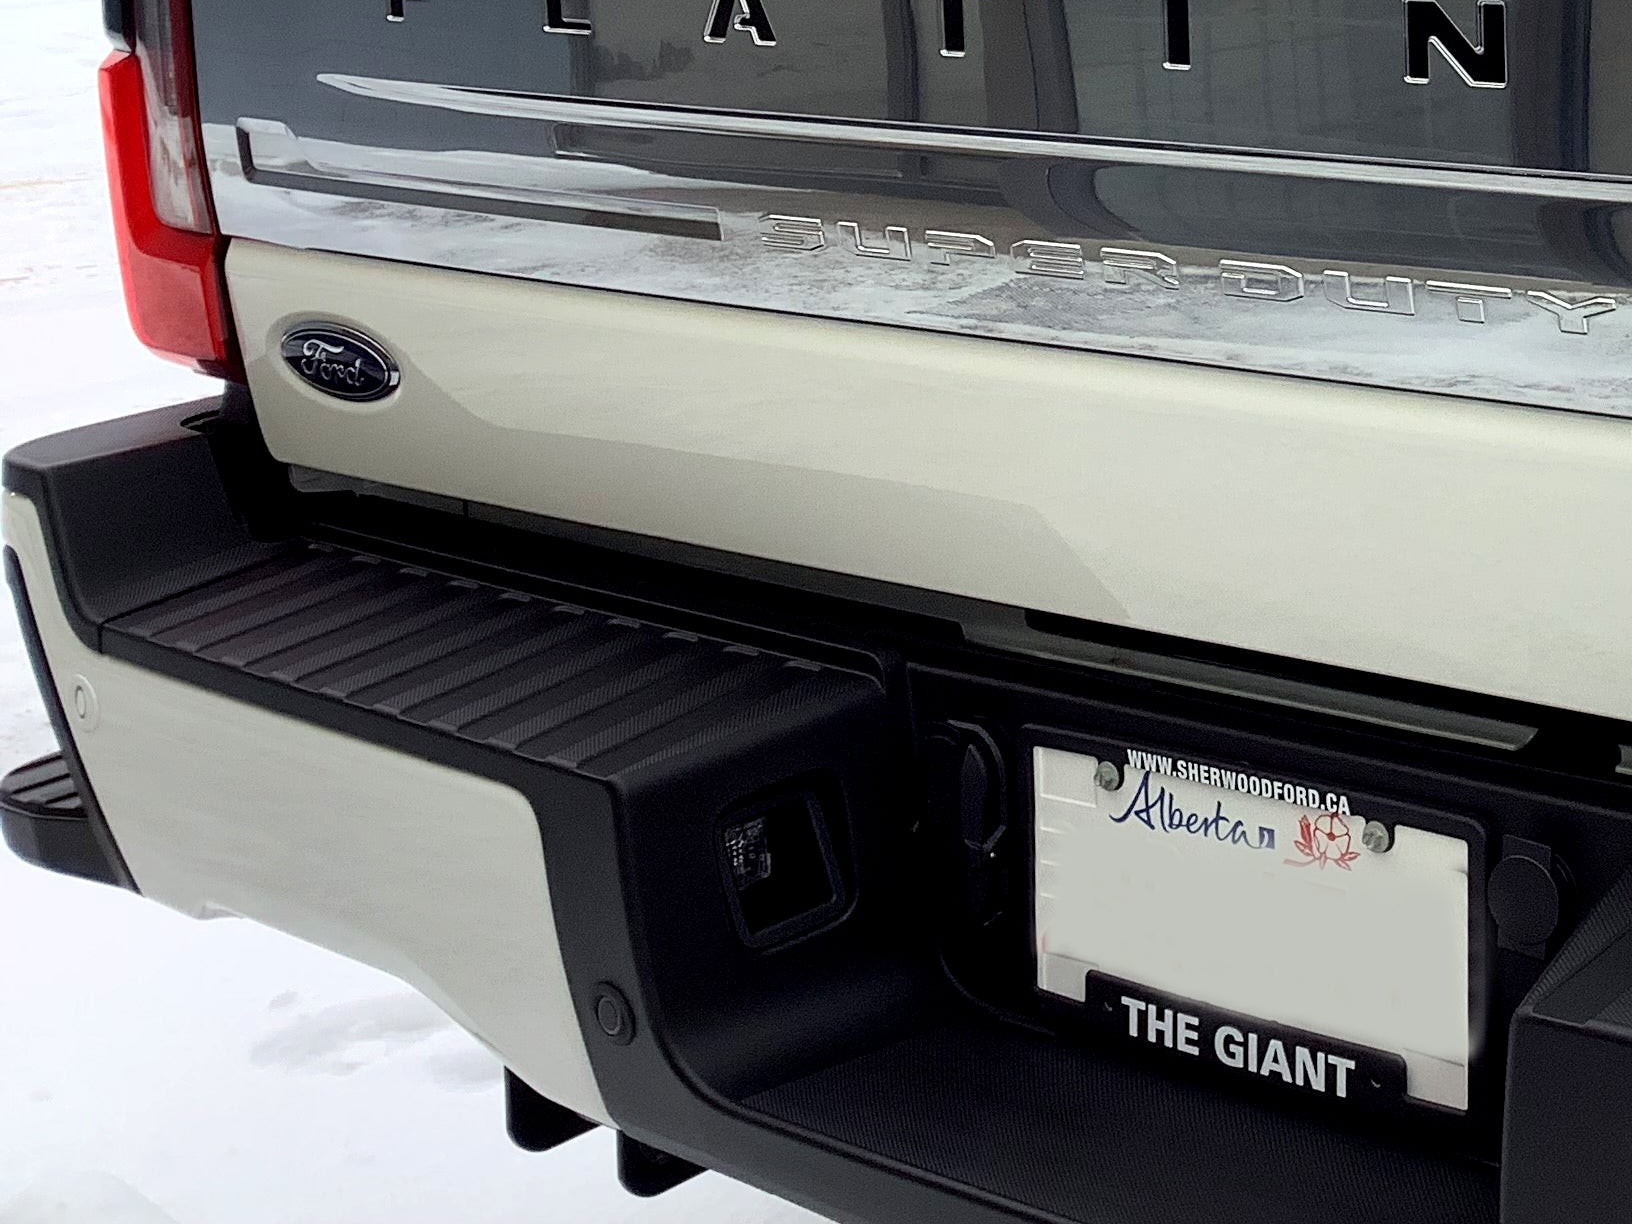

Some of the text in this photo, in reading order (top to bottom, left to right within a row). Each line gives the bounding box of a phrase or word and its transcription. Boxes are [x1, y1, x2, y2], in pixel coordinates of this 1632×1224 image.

[759, 214, 1617, 334] SUPER DUTY
[300, 338, 364, 387] Ford
[1109, 770, 1260, 849] Alberta
[1127, 749, 1350, 815] WWW.SHERWOODFORD.CA
[1121, 995, 1356, 1098] THE GIANT
